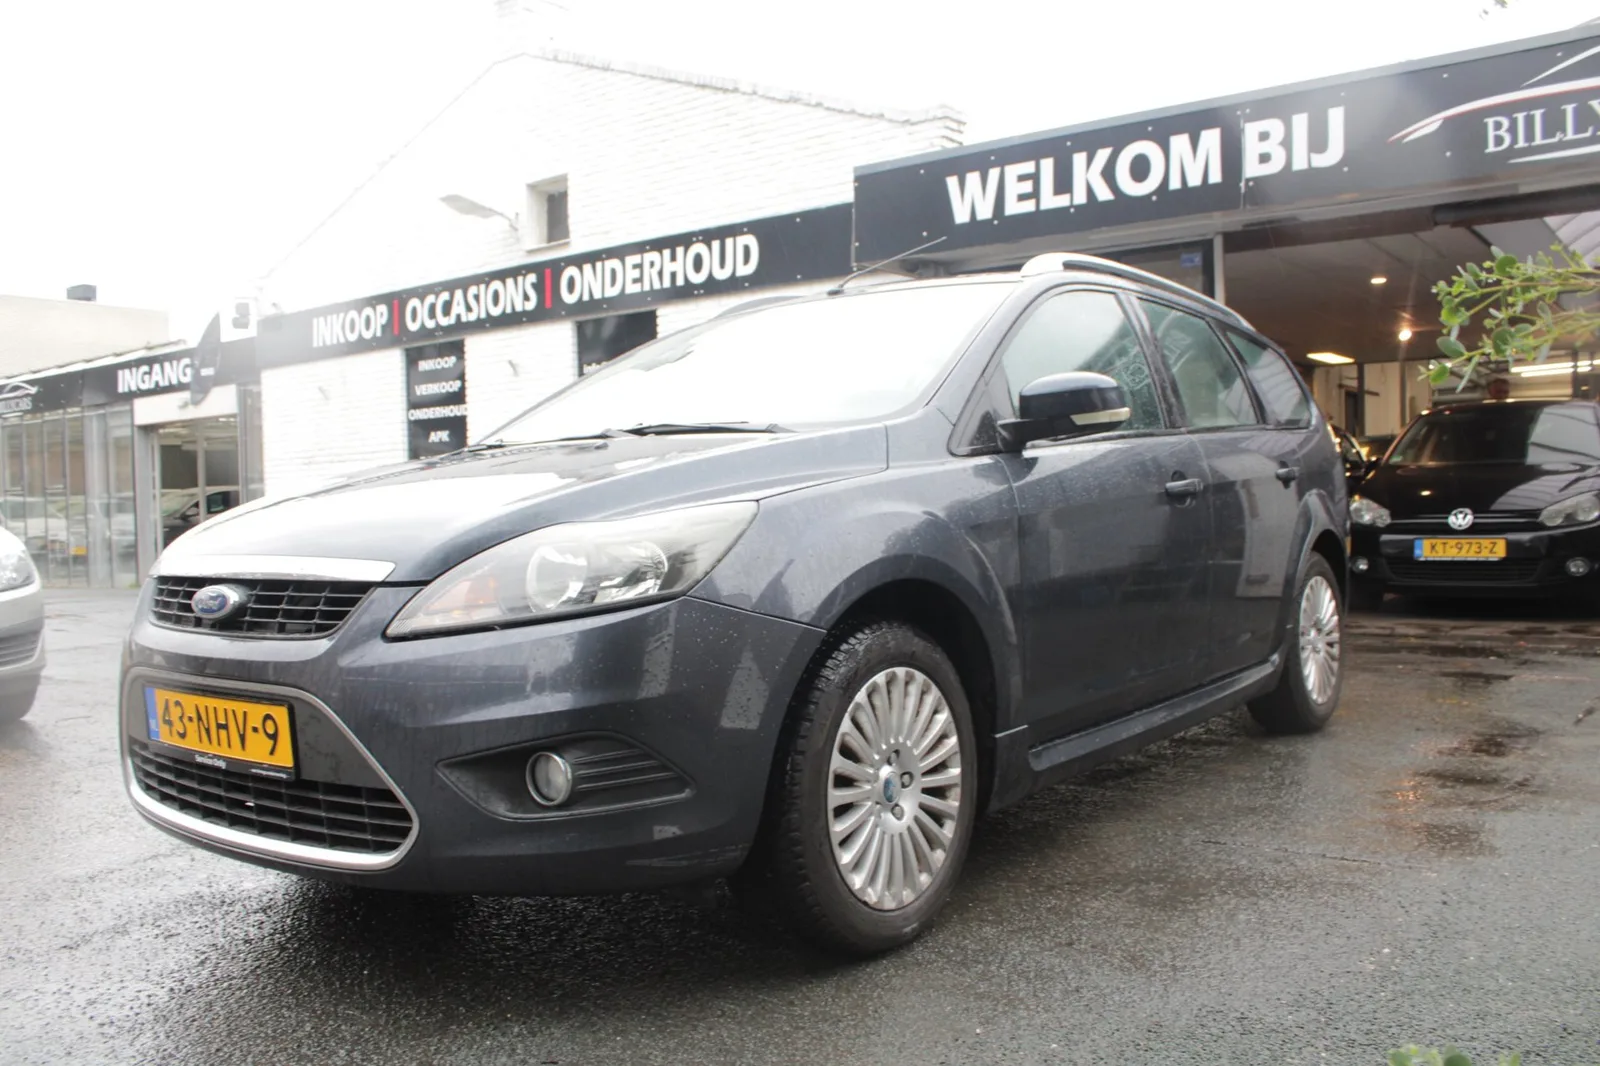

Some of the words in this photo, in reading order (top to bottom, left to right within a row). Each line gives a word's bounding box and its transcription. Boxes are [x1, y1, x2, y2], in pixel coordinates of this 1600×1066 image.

[945, 127, 1223, 225] WELKOM
[1243, 106, 1345, 179] BIJ
[312, 304, 388, 347] INKOOP
[404, 273, 538, 332] OCCASIONS
[559, 233, 760, 304] ONDERHOUD
[417, 356, 457, 372] INKOOP
[117, 357, 192, 393] INGANG
[414, 380, 462, 396] VERKOOP
[408, 404, 470, 421] ONDERHOUD
[428, 430, 450, 443] APK
[1429, 540, 1498, 555] KT-973-Z
[161, 698, 280, 757] 43-NHV-9
